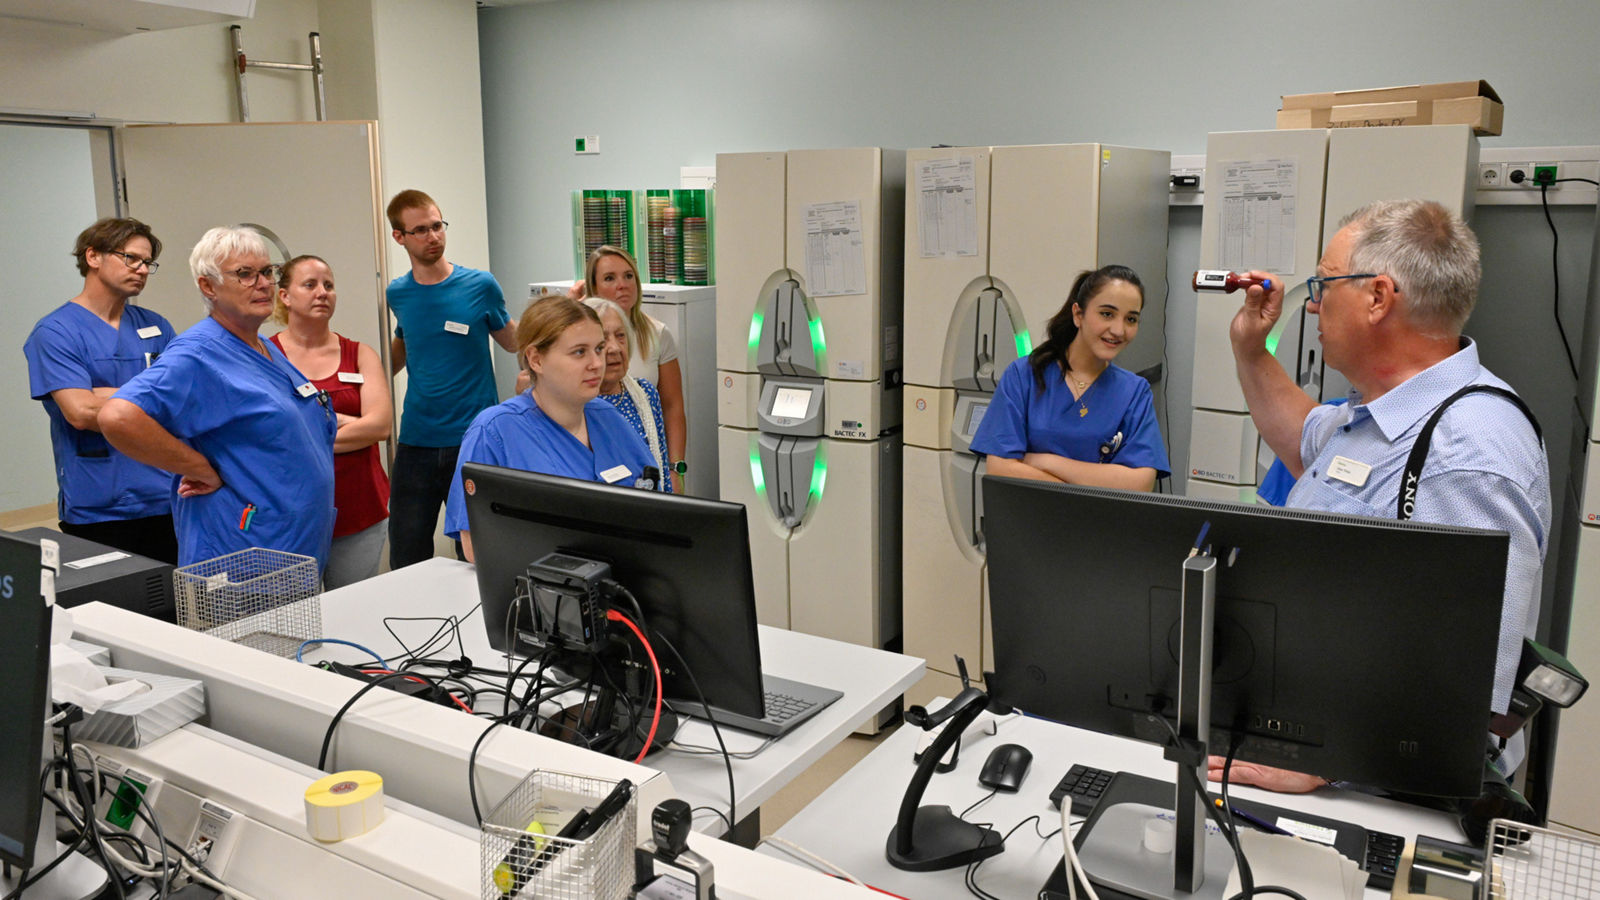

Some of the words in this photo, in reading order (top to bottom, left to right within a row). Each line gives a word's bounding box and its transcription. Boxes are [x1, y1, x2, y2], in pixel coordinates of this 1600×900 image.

[834, 429, 856, 437] BACTEC
[1206, 471, 1225, 479] BACTEC
[1403, 470, 1417, 520] ONY
[0, 574, 14, 599] S
